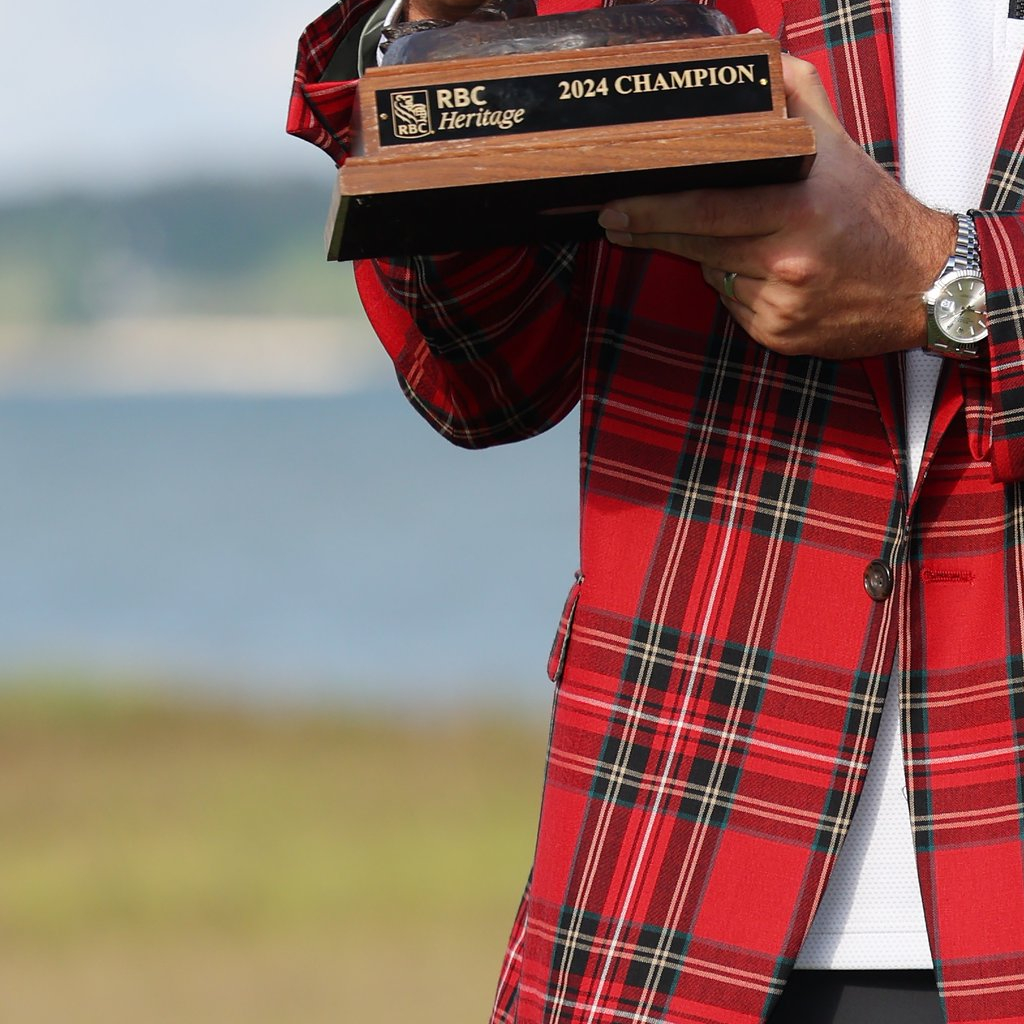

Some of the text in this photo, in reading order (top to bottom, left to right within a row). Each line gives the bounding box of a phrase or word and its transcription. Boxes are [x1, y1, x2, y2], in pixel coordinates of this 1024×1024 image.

[557, 64, 755, 100] 2024 CHAMPION
[437, 86, 487, 108] RBC
[397, 122, 428, 136] RBC
[438, 107, 526, 131] Heritage
